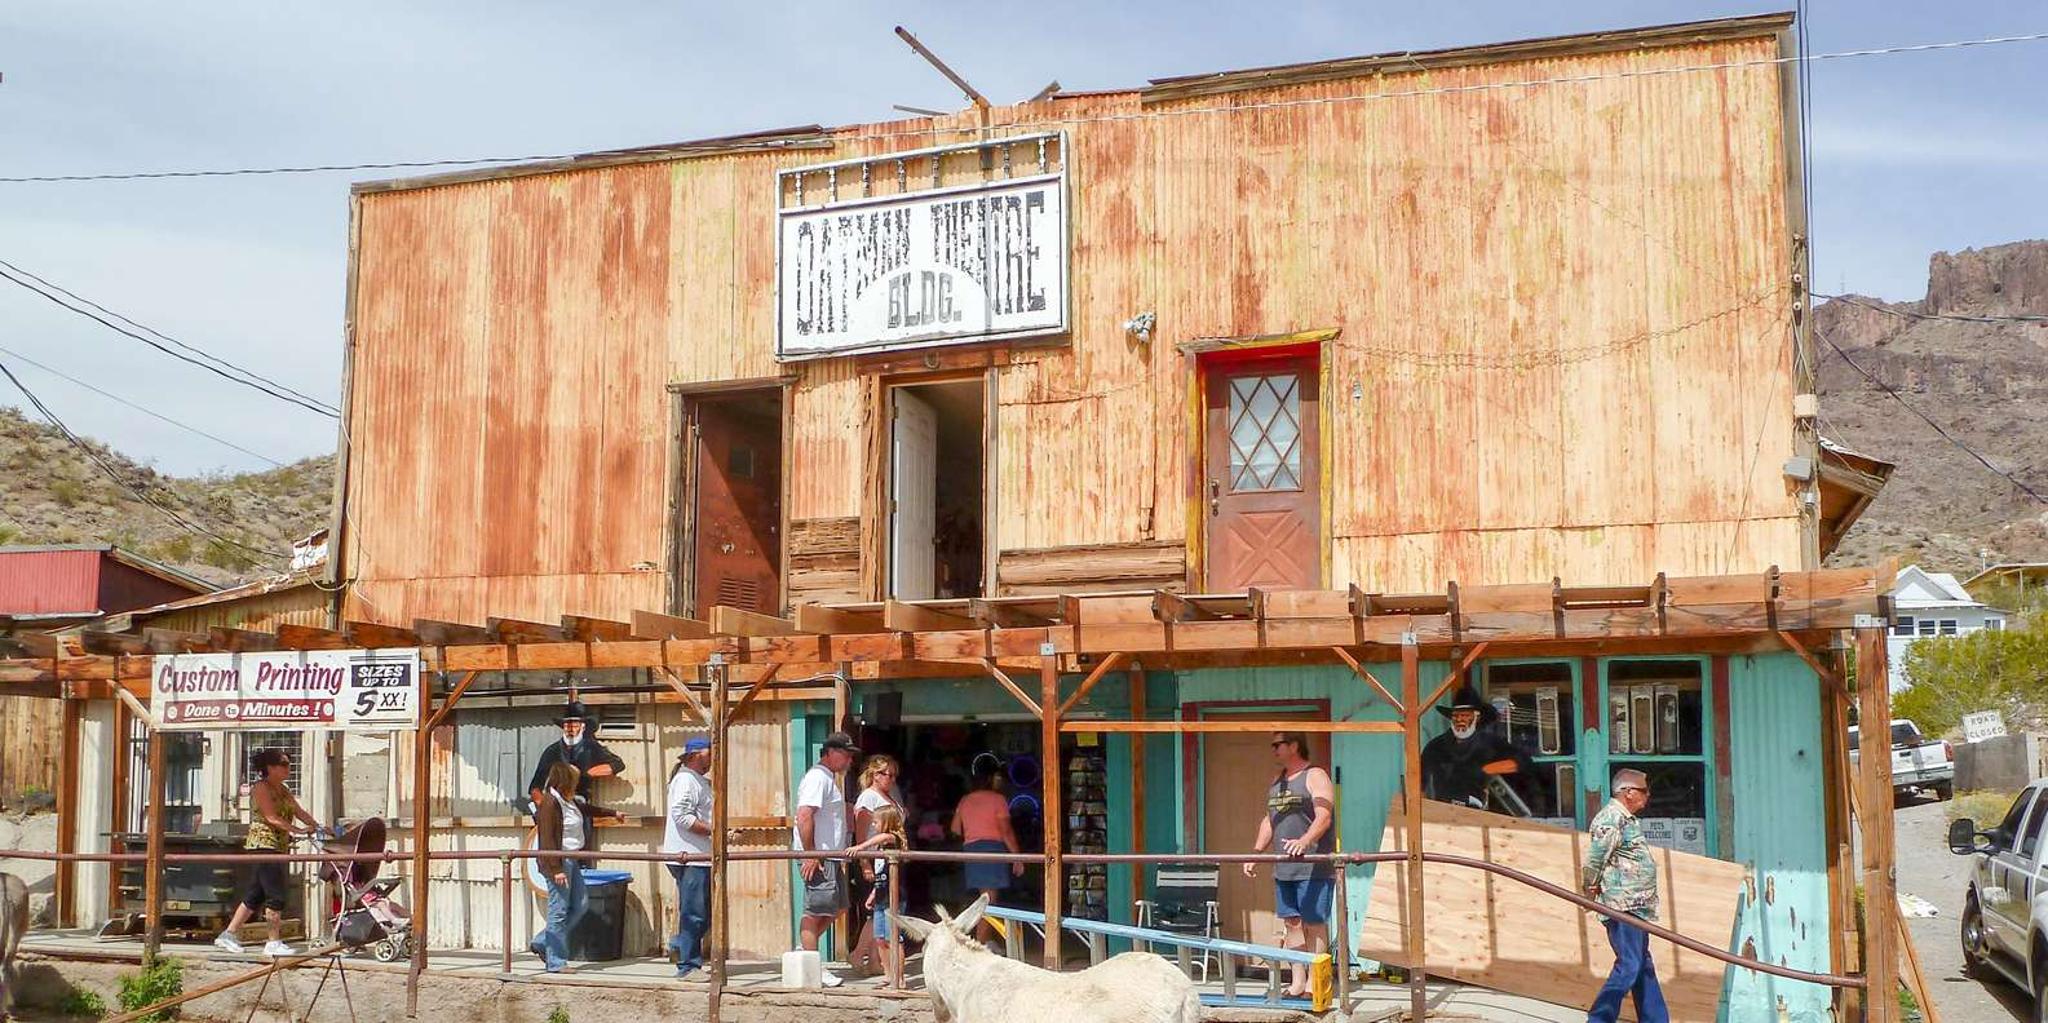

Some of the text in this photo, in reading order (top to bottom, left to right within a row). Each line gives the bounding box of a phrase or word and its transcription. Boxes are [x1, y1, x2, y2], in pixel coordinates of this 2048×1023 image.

[887, 269, 962, 329] BLDG.
[158, 660, 346, 696] Custom Printing
[357, 665, 404, 678] SIZES
[362, 677, 400, 687] UP TO
[353, 689, 379, 717] 5
[184, 703, 221, 717] Done
[1971, 713, 1996, 725] ROAD
[1970, 726, 2004, 738] CLOSED
